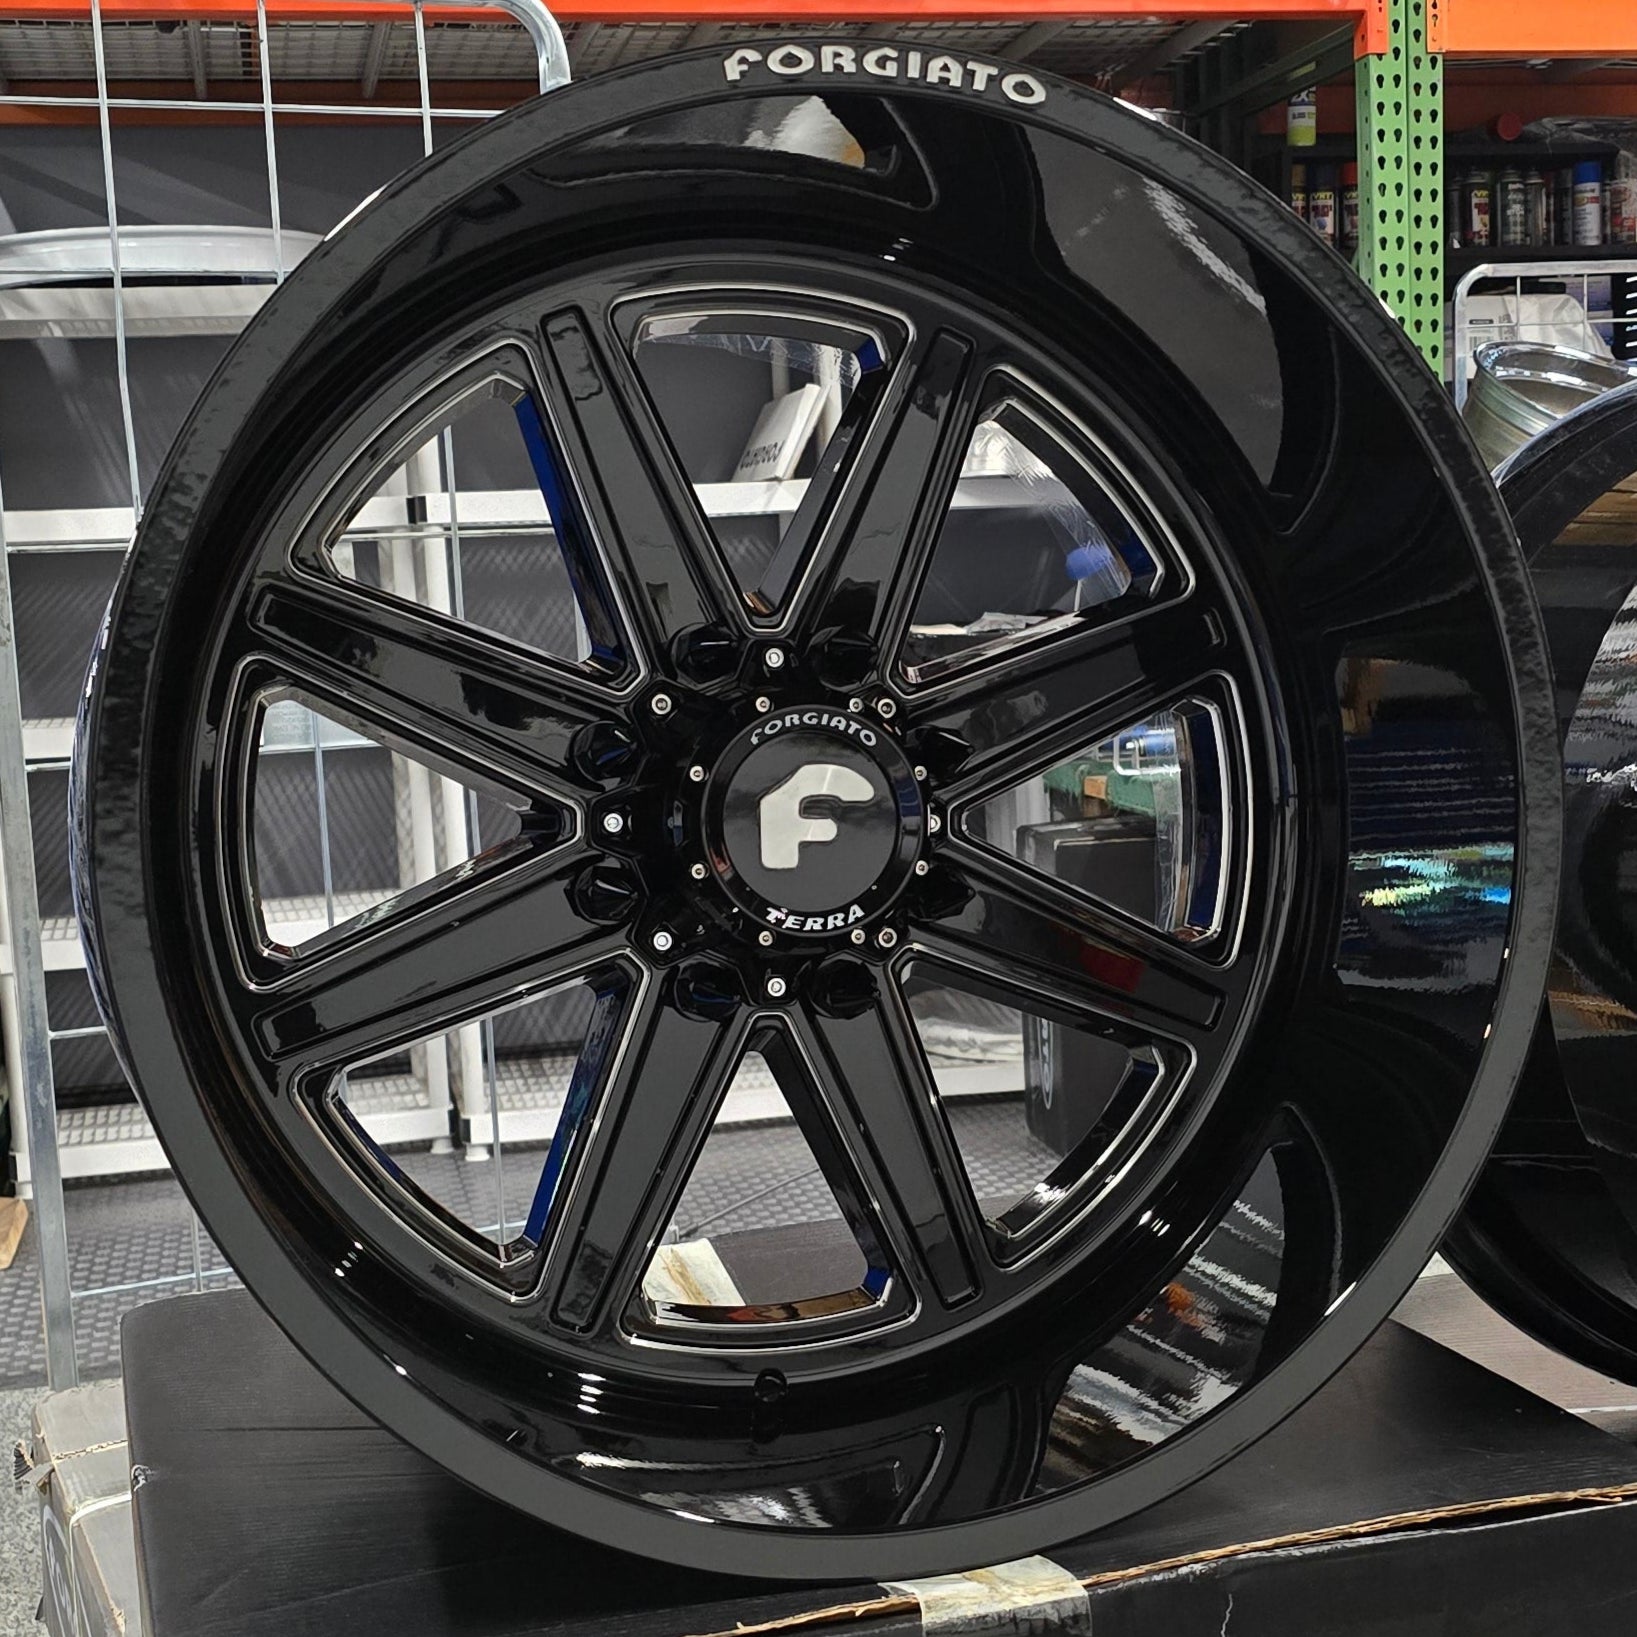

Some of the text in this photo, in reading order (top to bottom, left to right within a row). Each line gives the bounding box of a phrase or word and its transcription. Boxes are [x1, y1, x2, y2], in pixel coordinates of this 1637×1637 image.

[723, 44, 1047, 104] FORGIATO
[750, 711, 877, 746] FORGIATO
[760, 763, 875, 869] F
[766, 904, 865, 931] TERRA
